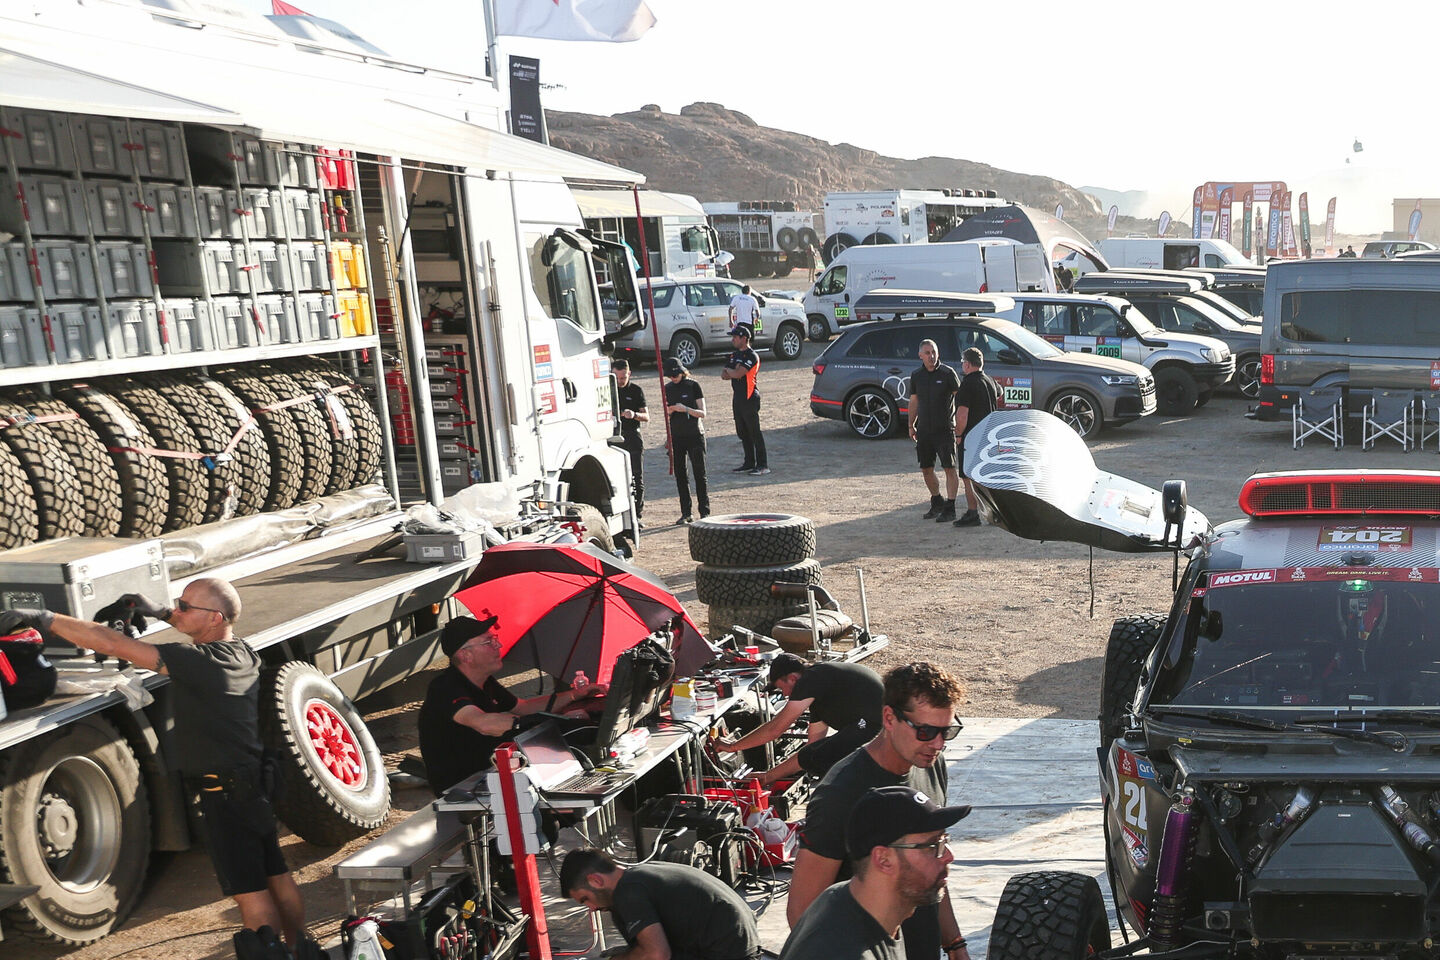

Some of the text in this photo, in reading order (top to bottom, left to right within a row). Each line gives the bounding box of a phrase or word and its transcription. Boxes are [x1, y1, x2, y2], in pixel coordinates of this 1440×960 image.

[1098, 347, 1120, 358] 2009
[1006, 389, 1030, 401] 1260
[1328, 530, 1402, 542] 204
[1214, 571, 1273, 585] MOTUL
